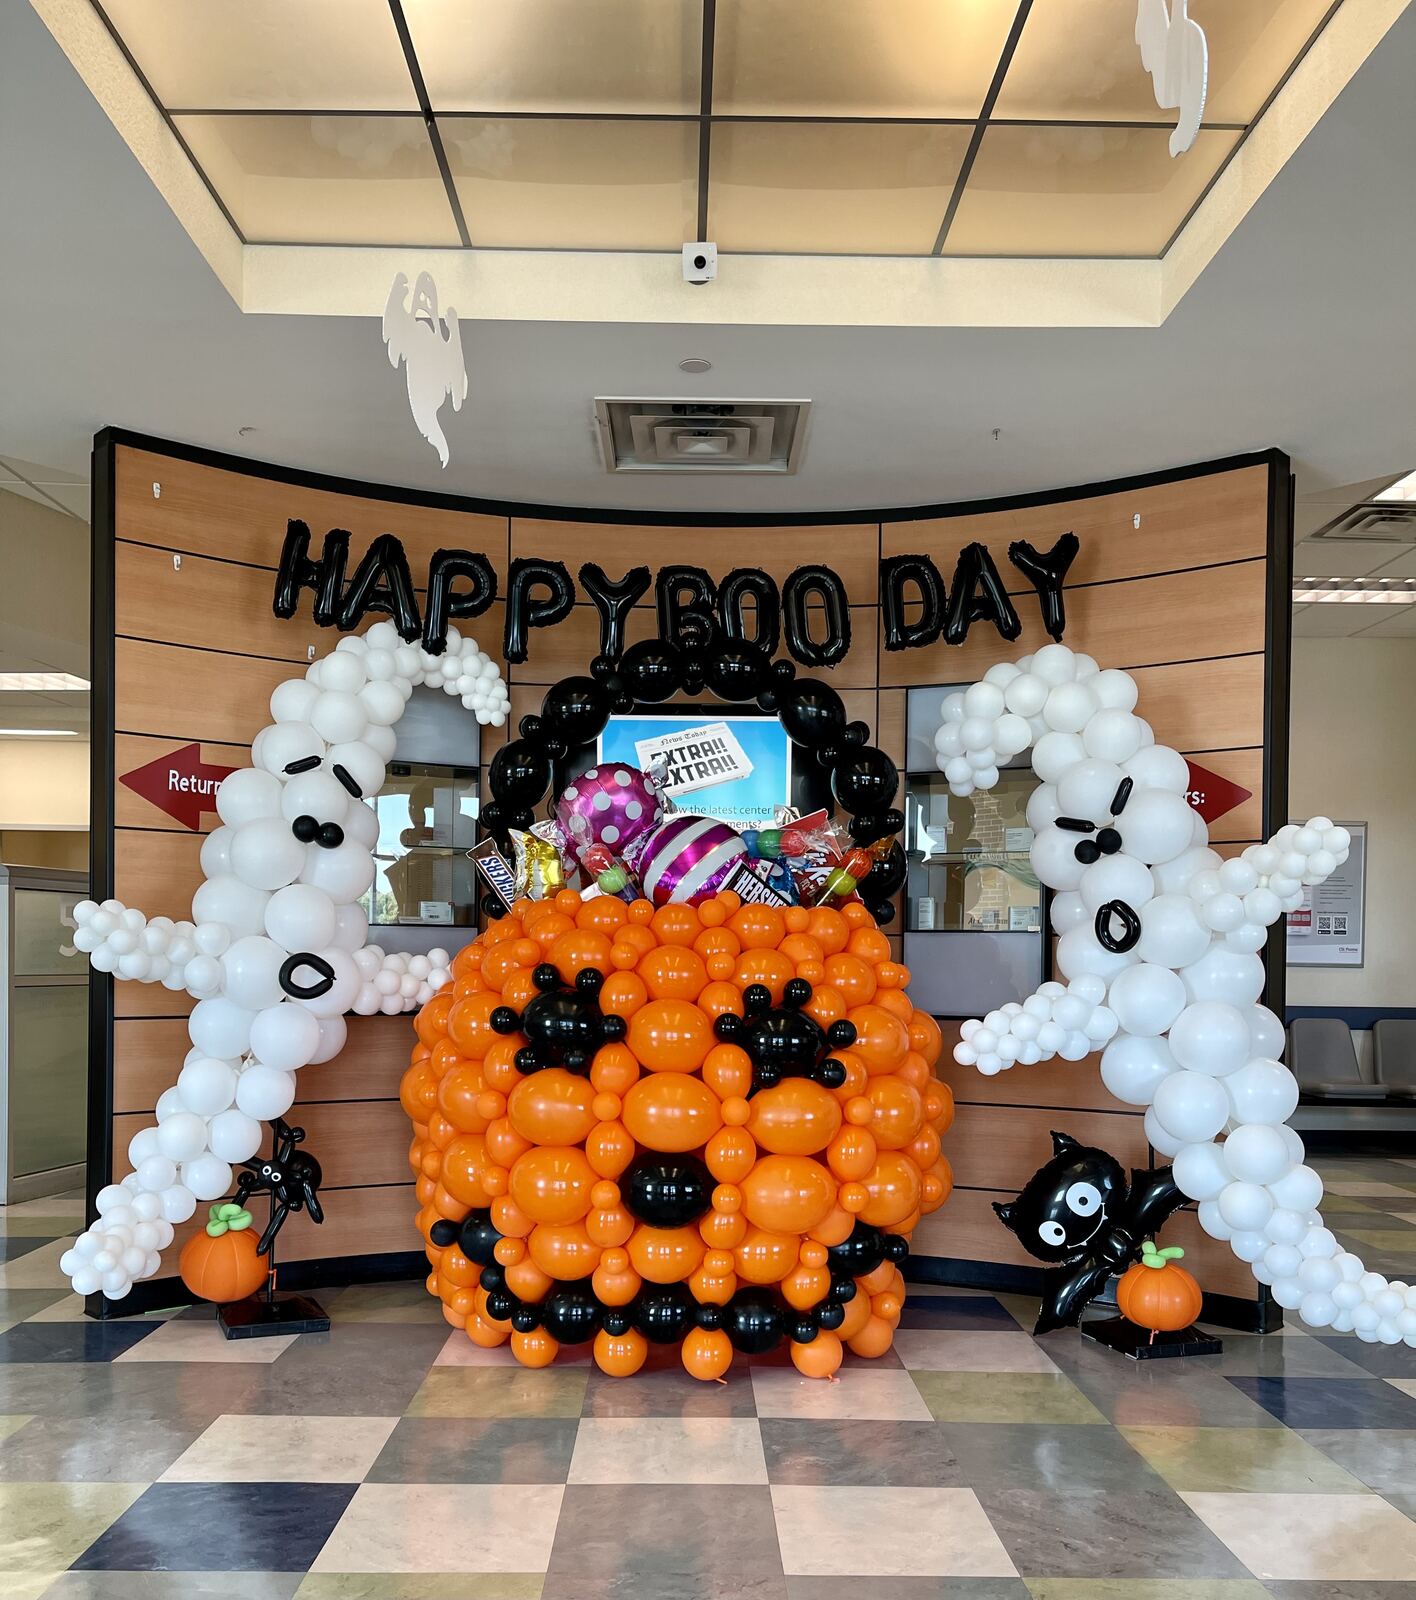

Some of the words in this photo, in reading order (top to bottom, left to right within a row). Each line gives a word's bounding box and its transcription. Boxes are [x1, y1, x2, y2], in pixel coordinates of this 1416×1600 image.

[655, 564, 852, 669] BOO
[880, 531, 1080, 651] DAY
[661, 735, 683, 747] News
[684, 730, 708, 740] Today
[661, 754, 739, 788] XTRA!!
[690, 805, 707, 815] the
[709, 805, 738, 815] latest
[739, 806, 772, 815] center
